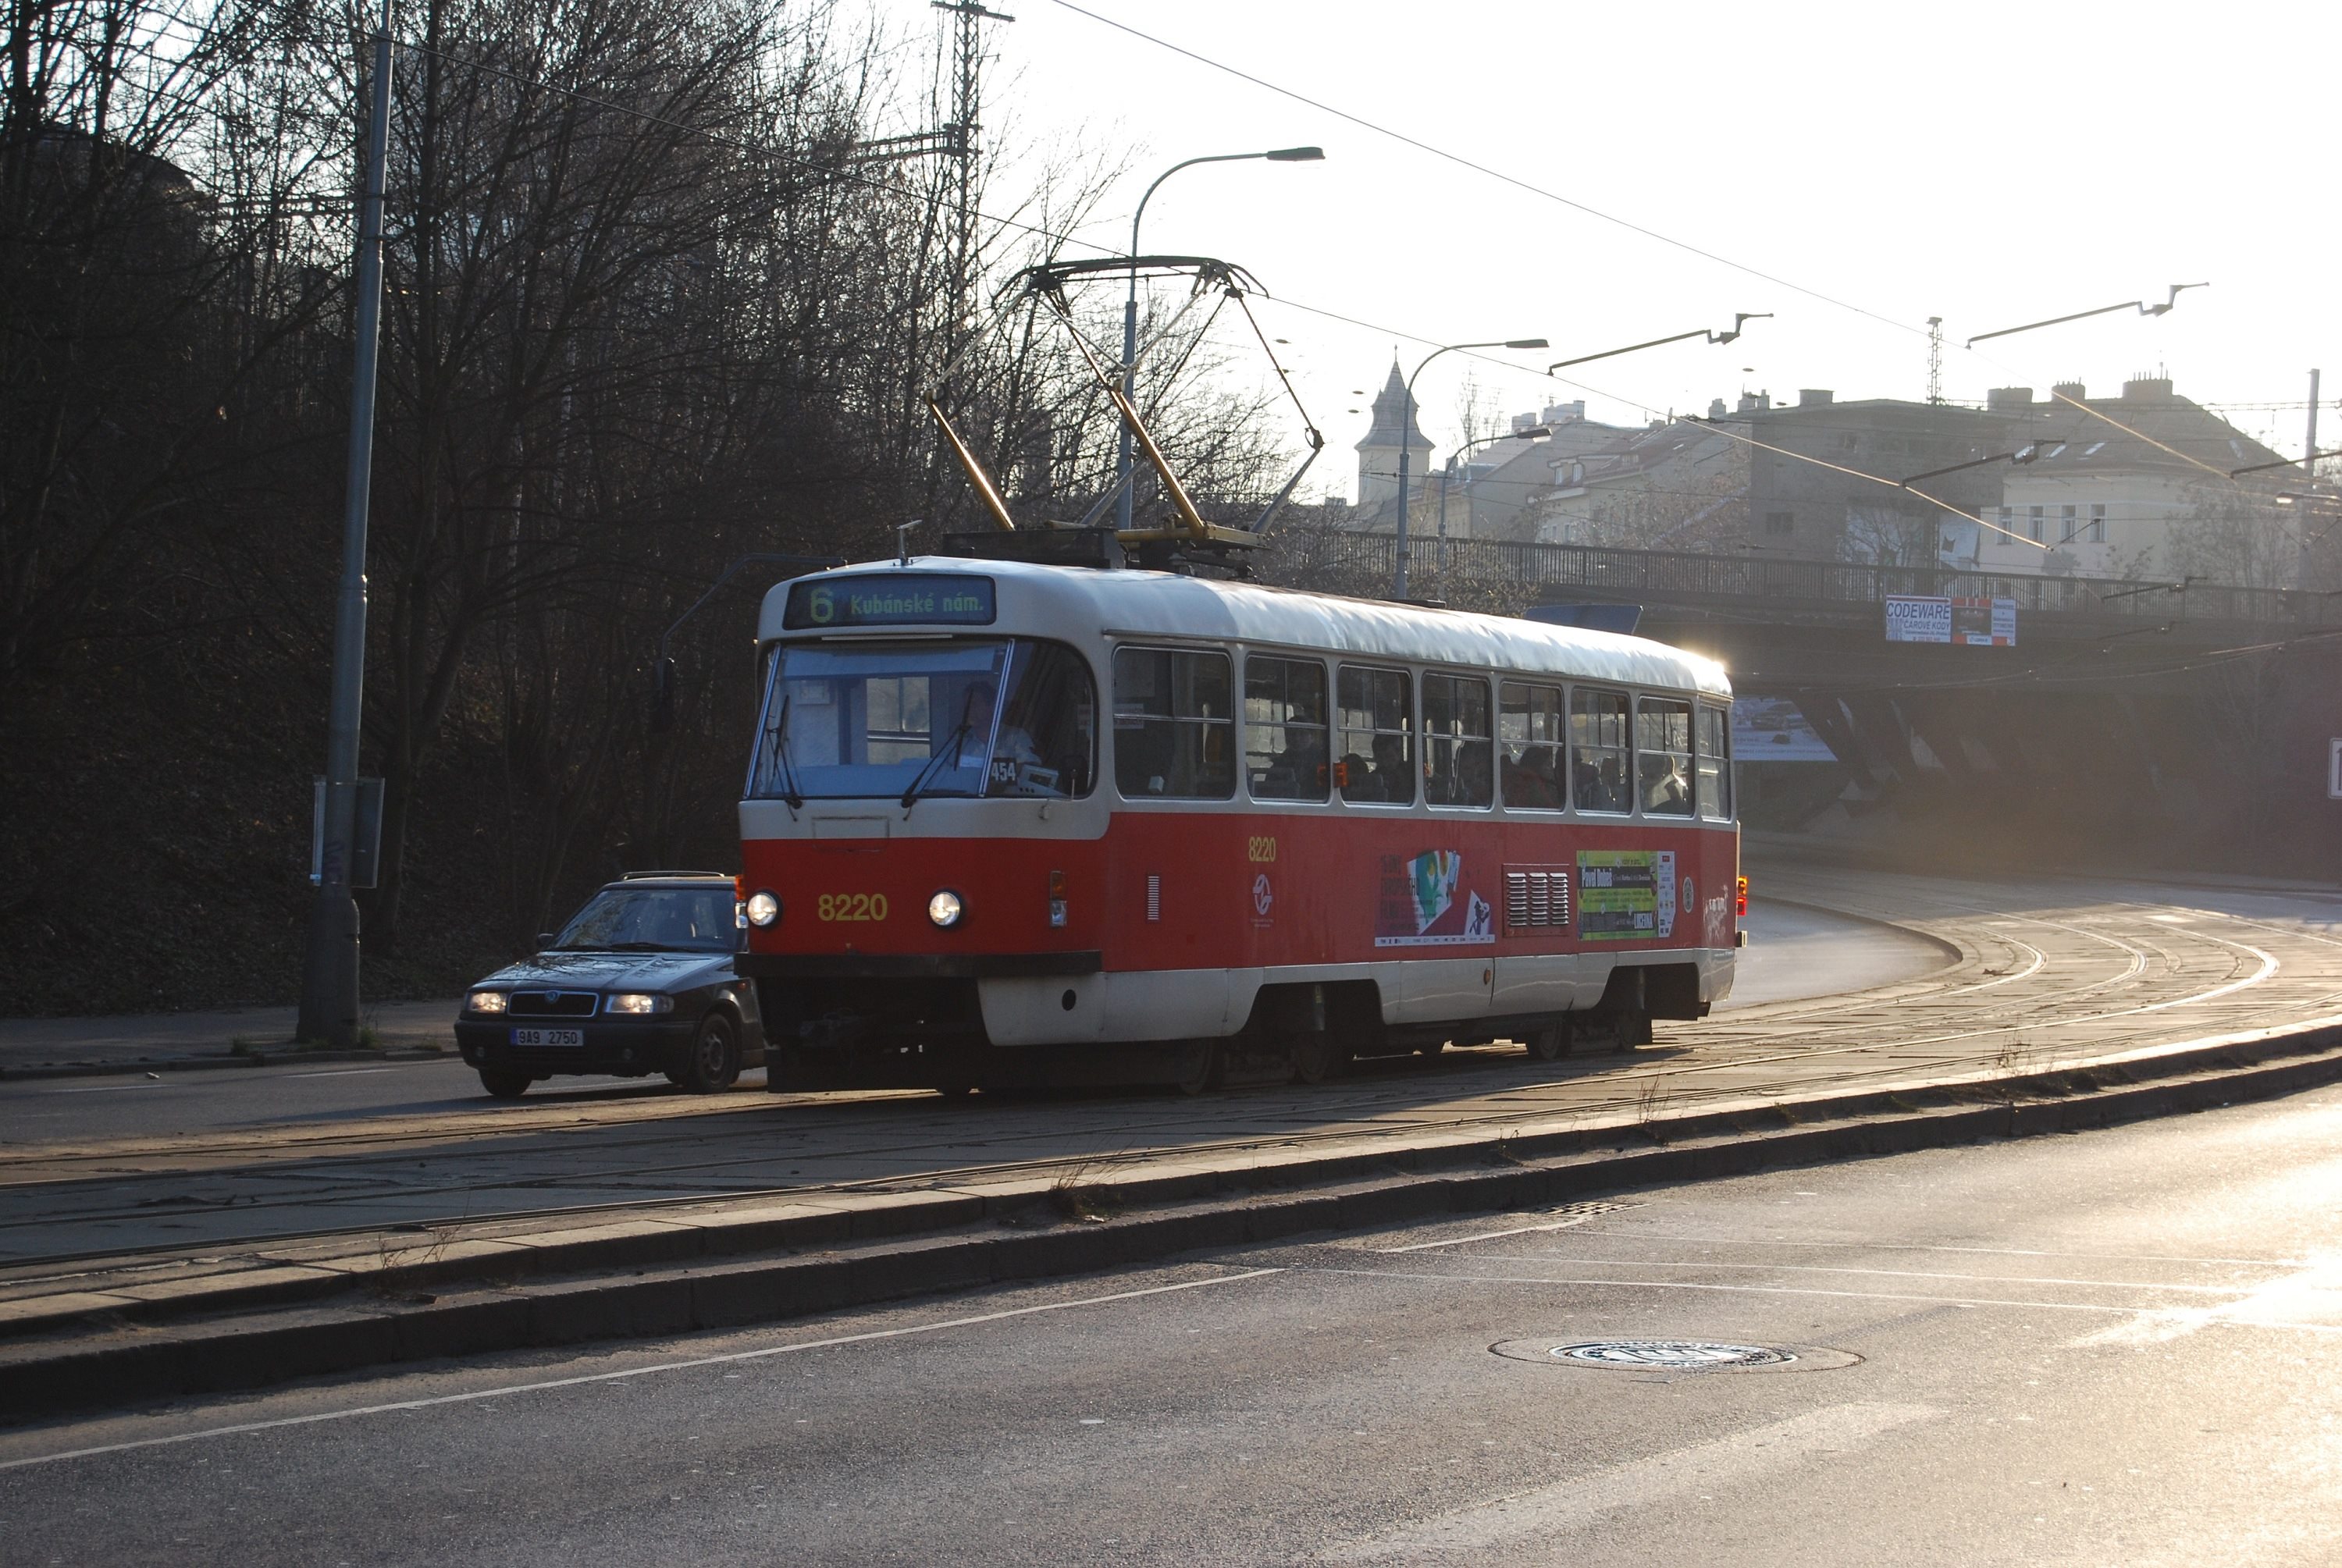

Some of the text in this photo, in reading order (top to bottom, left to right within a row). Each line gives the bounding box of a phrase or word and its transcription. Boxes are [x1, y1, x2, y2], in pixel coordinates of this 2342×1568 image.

[810, 587, 984, 623] 6 Kubánské nám.
[1886, 603, 1949, 620] CODEWARE
[991, 762, 1016, 781] 454
[1248, 836, 1276, 862] 8220
[818, 894, 888, 922] 8220
[518, 1031, 578, 1044] 9A9 2750
